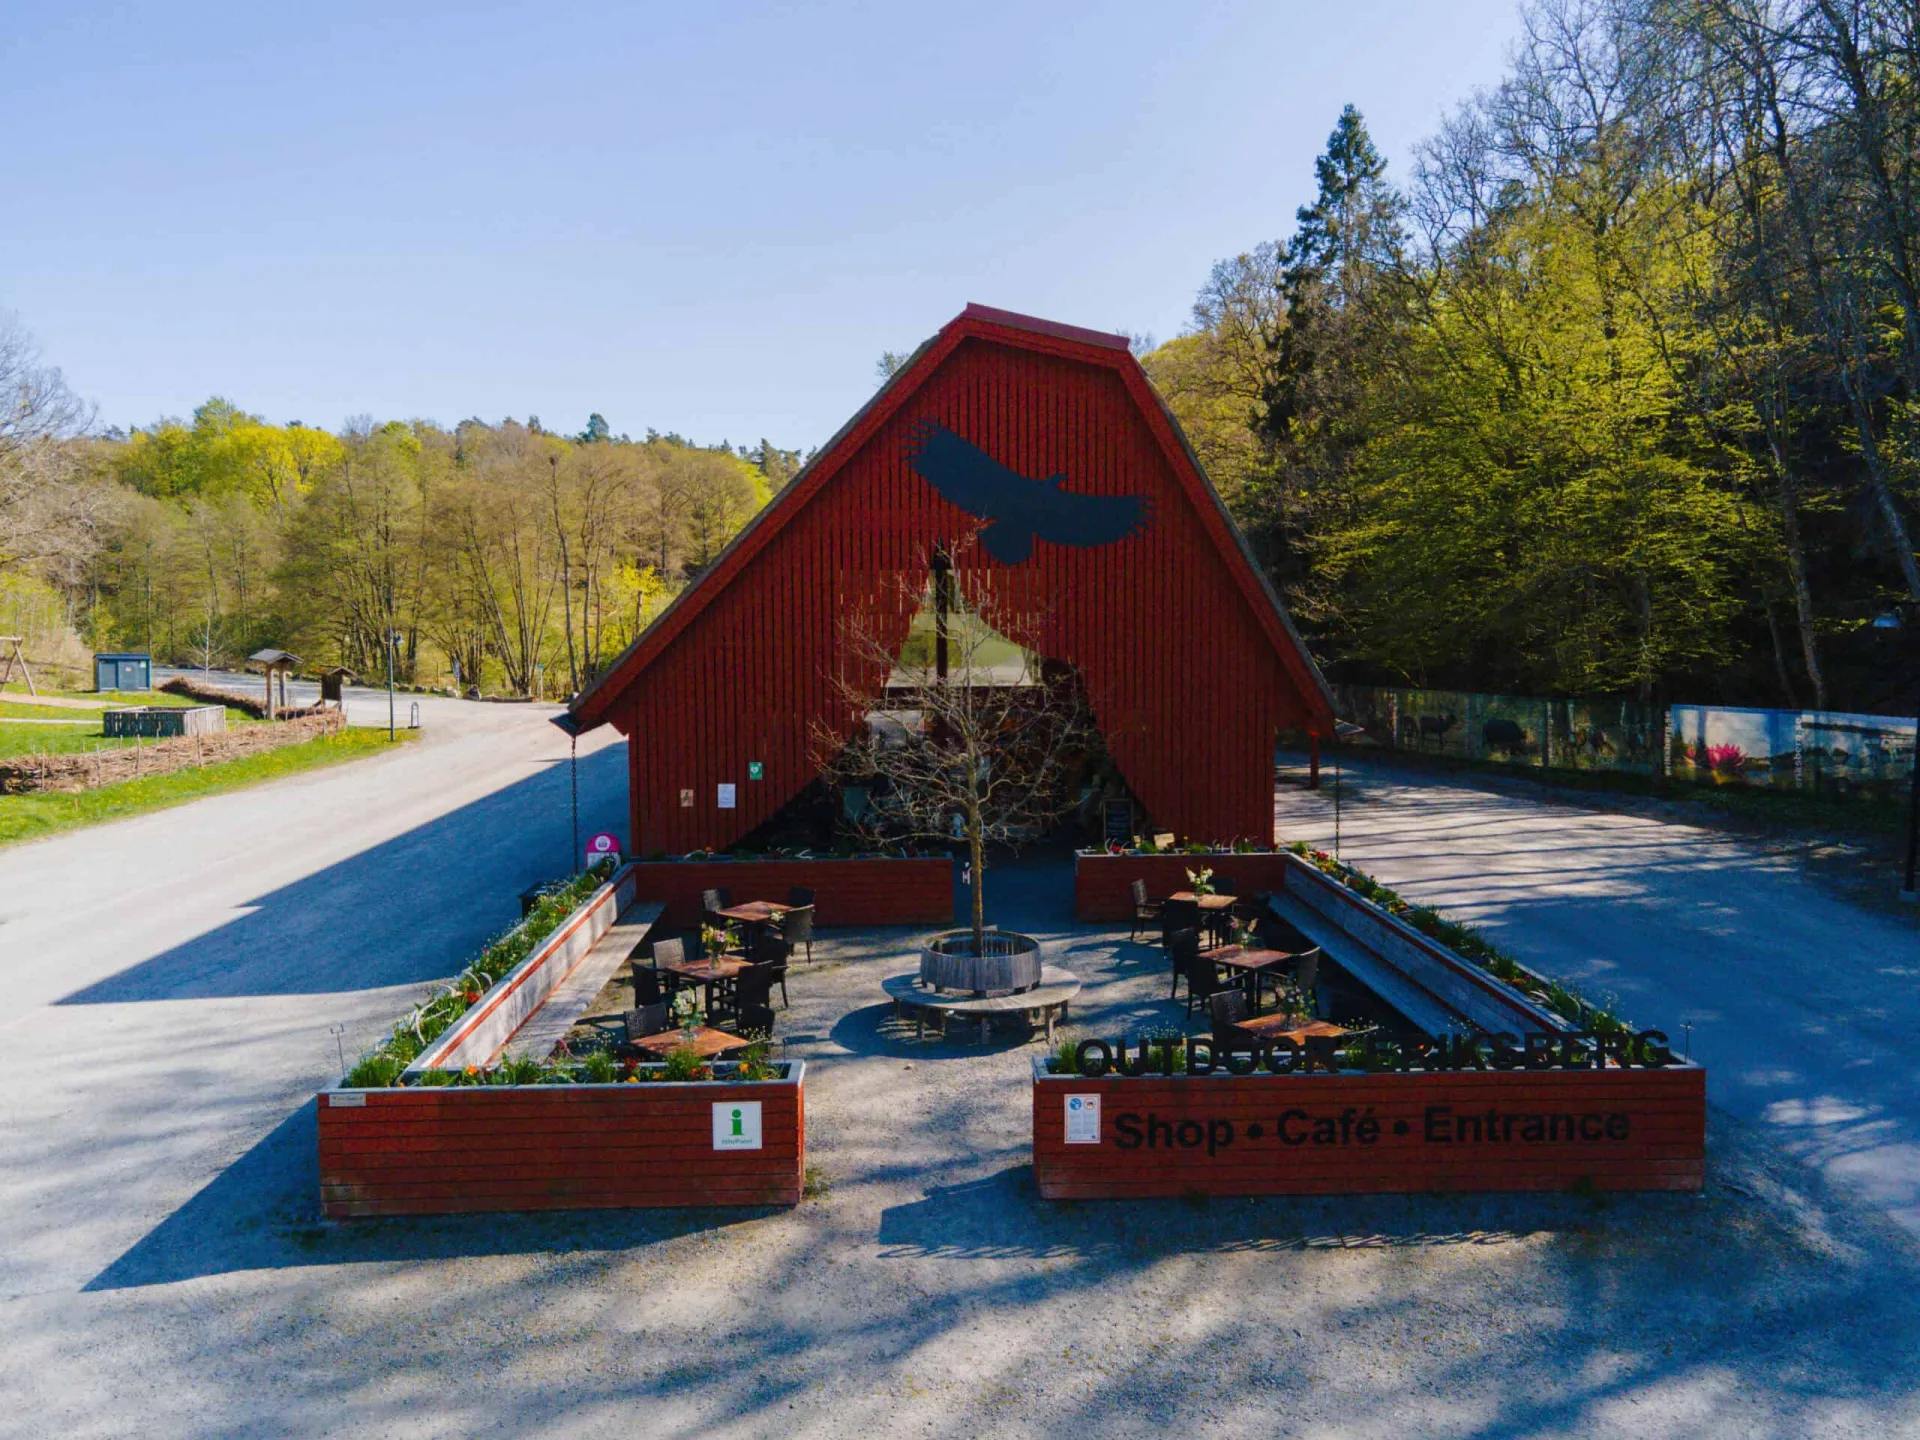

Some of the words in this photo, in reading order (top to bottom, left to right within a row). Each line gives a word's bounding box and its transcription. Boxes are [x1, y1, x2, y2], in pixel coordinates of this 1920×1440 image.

[1076, 1036, 1341, 1077] OUTDOOR
[1367, 1030, 1671, 1070] ERIKSBERG
[1114, 1112, 1235, 1157] Shop
[1276, 1107, 1381, 1146] Café
[1423, 1105, 1631, 1143] Entrance
